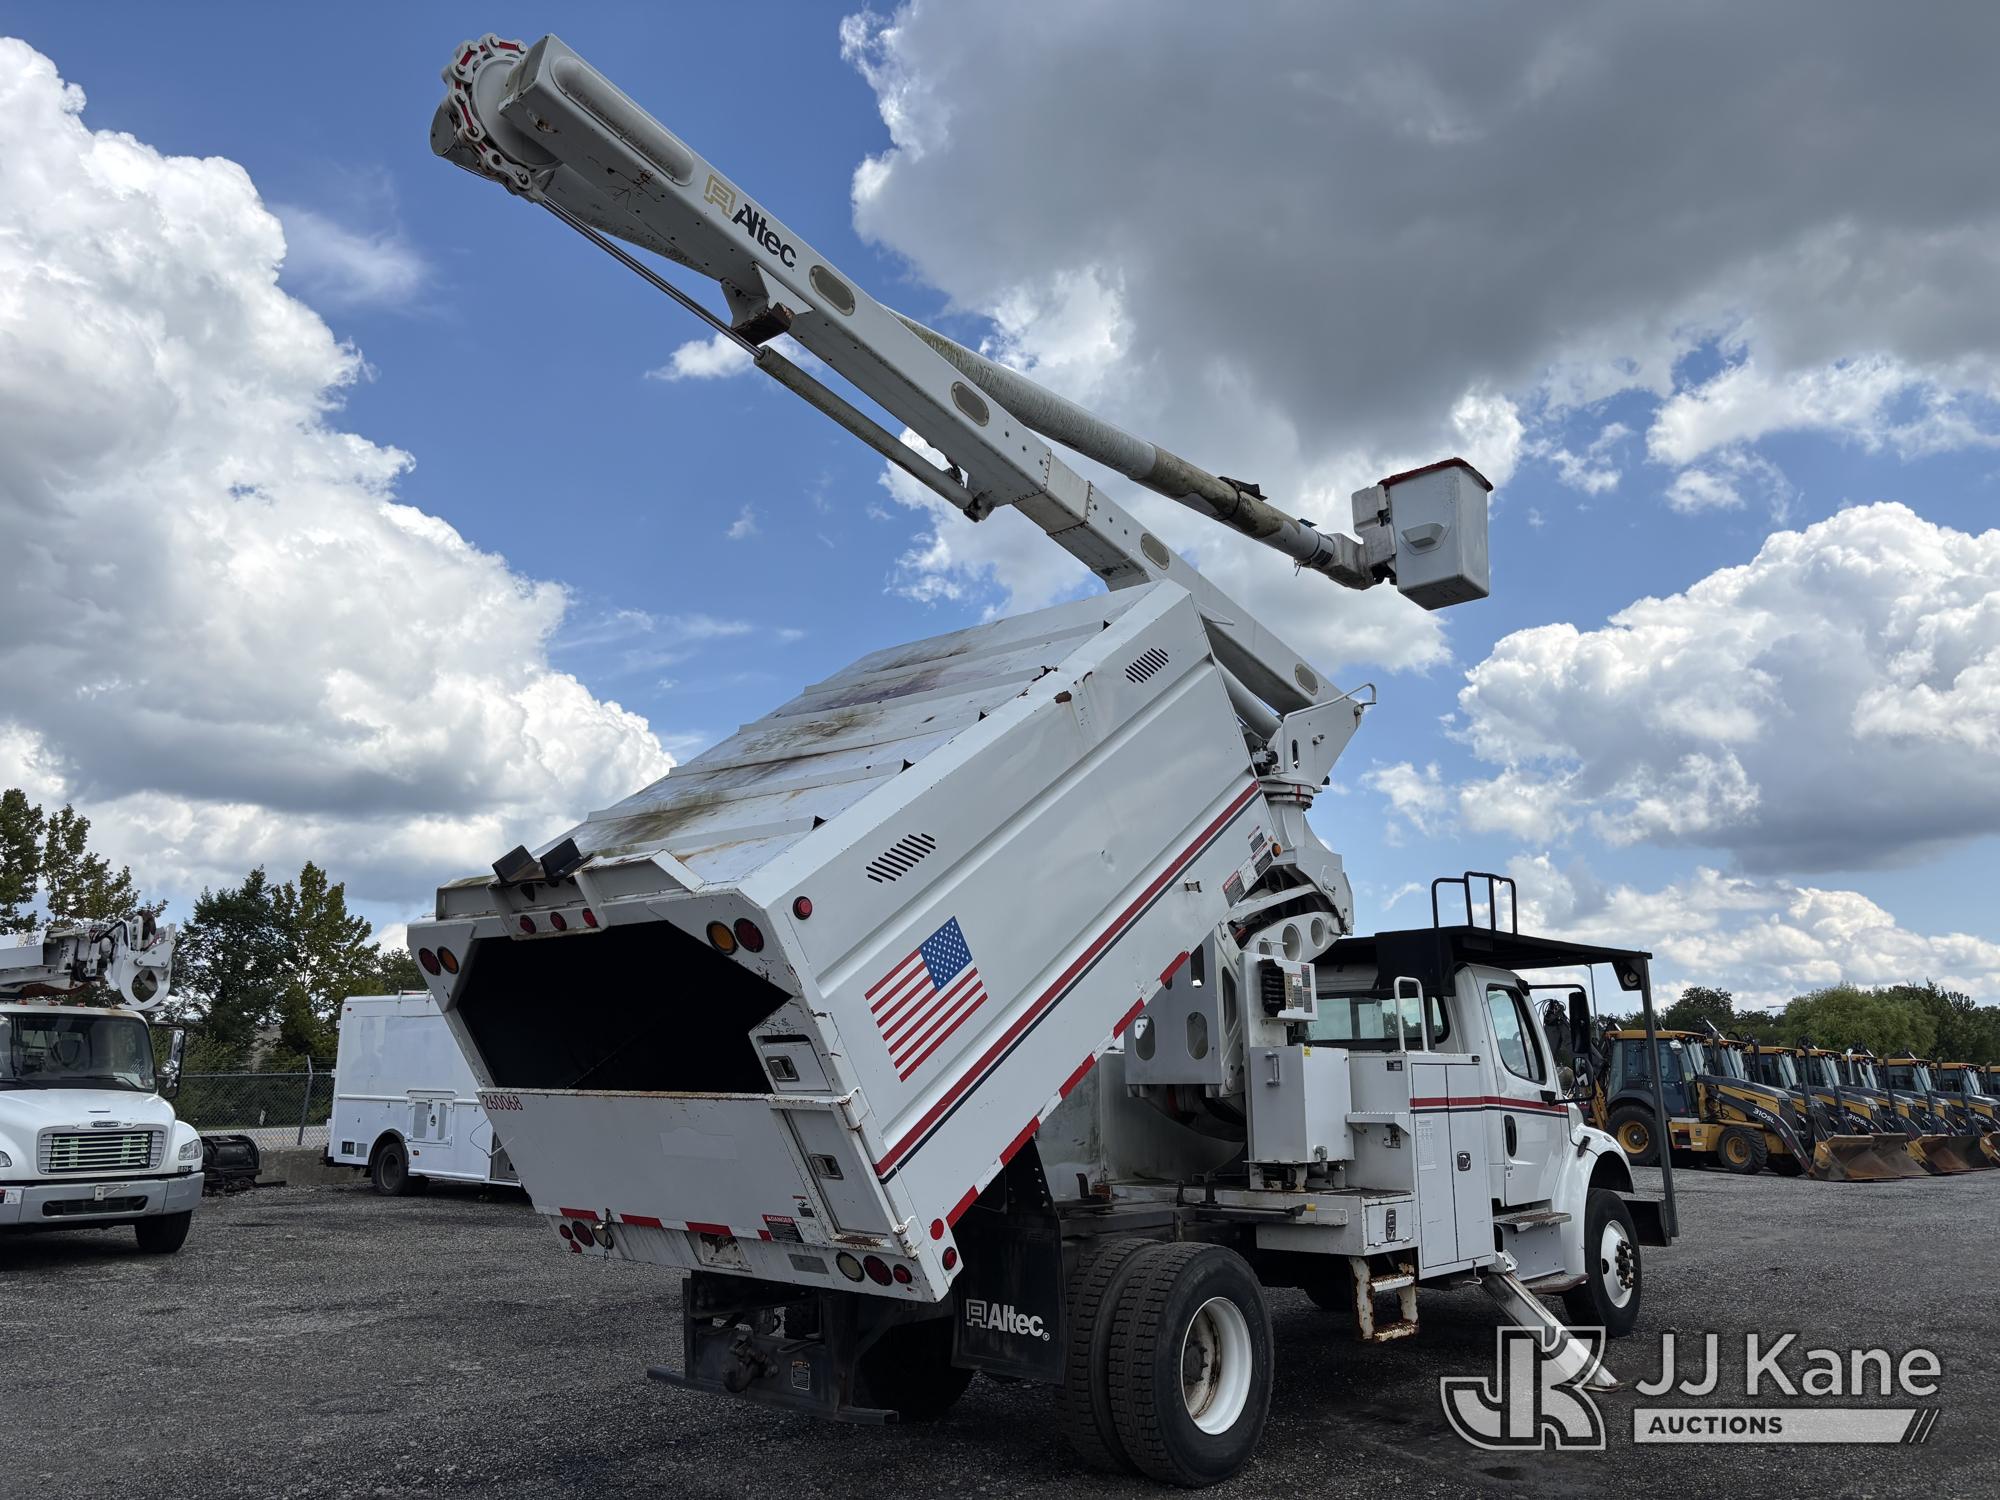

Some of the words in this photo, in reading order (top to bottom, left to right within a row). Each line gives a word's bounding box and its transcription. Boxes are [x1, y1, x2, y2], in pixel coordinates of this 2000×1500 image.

[732, 203, 797, 268] Altec
[482, 1094, 523, 1110] 260068
[1753, 1107, 1775, 1124] 310SL
[987, 1303, 1044, 1337] Altec
